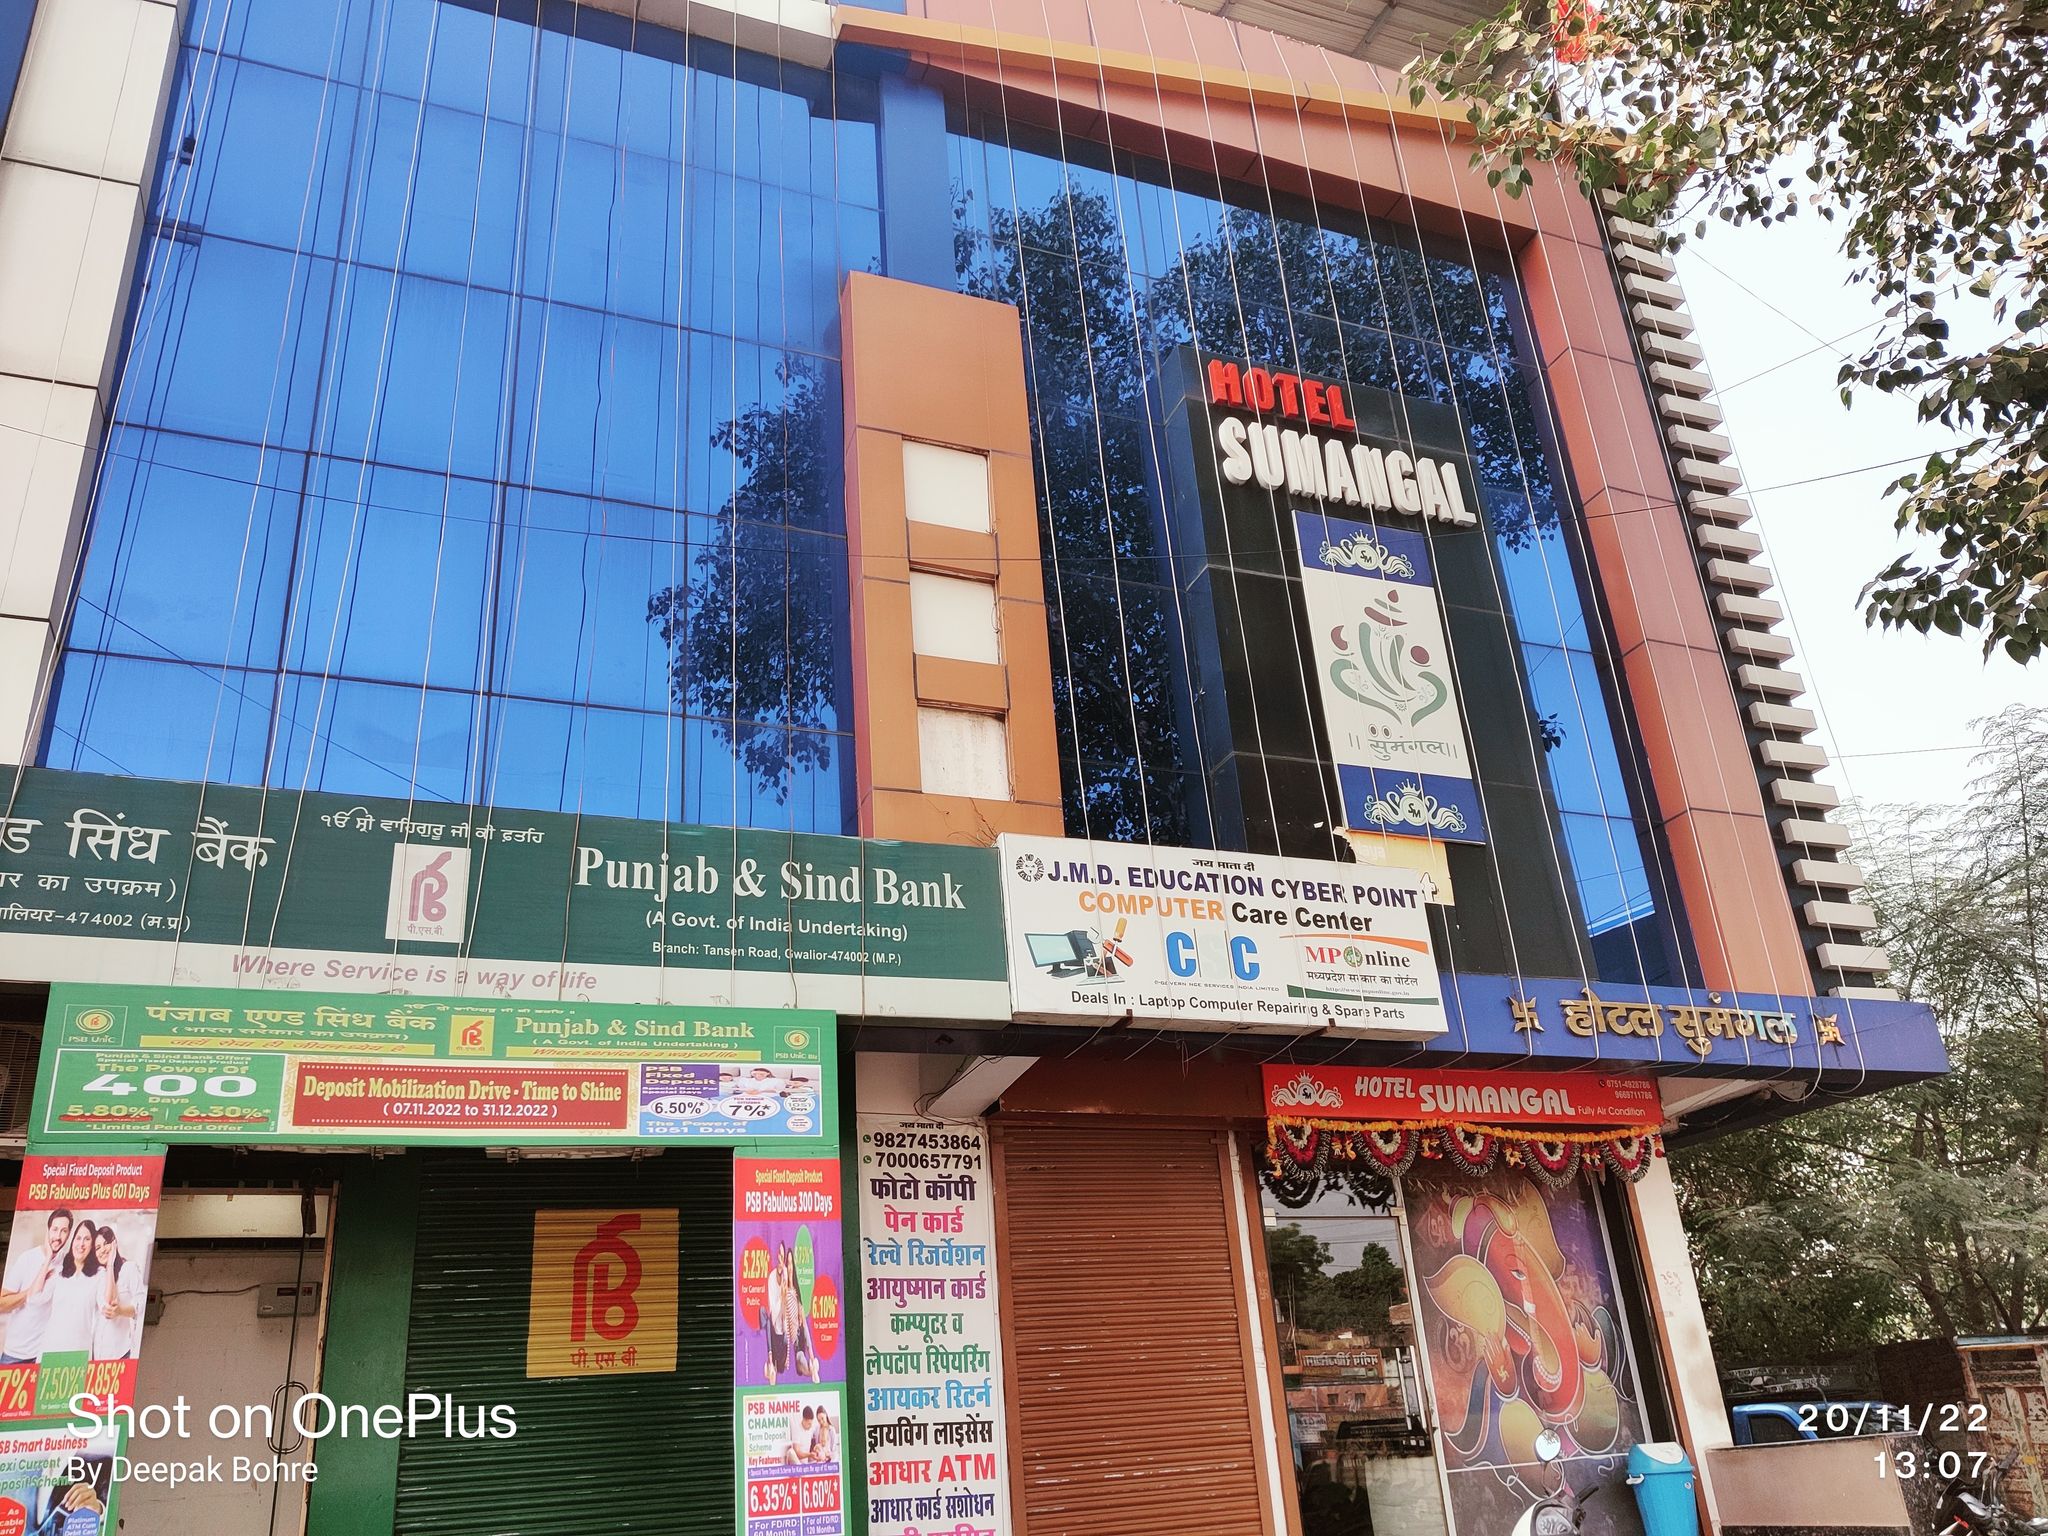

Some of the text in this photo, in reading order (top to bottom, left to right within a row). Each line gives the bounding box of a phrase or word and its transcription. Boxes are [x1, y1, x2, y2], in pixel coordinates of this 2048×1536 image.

[1207, 359, 1355, 431] HOTEL
[1218, 417, 1477, 526] SUMANGAL
[64, 808, 277, 871] सिंध बैंक
[37, 874, 70, 892] का
[574, 846, 966, 910] Punjab & Sind Bank
[1048, 861, 1120, 885] J.M.D.
[1128, 866, 1264, 897] EDUCATION
[1271, 878, 1347, 903] CYBER
[1353, 886, 1417, 909] POINT
[645, 910, 908, 942] (A Govt. of India Undertaking)
[1079, 891, 1372, 932] COMPUTER Care Center
[653, 942, 901, 966] Branch: Tansen Road, Gwalior-474002 (M.P.)
[232, 954, 598, 990] Where Service is a way of life
[145, 1000, 437, 1030] पंजाब एण्ड सिंध बैंक
[1071, 991, 1405, 1019] Deals In Laptop Computer Repairing & Spare Parts
[515, 1016, 754, 1038] Punjab & Sind Bank
[1559, 987, 1798, 1056] होटल सुमंगल
[96, 1064, 249, 1074] The Power Of
[82, 1074, 257, 1097] 400
[148, 1096, 190, 1104] Days
[303, 1075, 622, 1101] Deposit Mobilization Drive Time to Shine
[1355, 1076, 1576, 1116] HOTEL SUMANGAL
[393, 1102, 548, 1116] 07.11.2022 to 31.12.2022
[873, 1132, 981, 1150] 9827453864
[43, 1163, 142, 1179] Special Fixed Deposit Product
[875, 1152, 982, 1170] 7000657791
[29, 1183, 150, 1202] PSB Fabulous Plus 601 Days
[870, 1172, 976, 1200] फोटो कॉपी
[745, 1190, 833, 1217] PSB Fabulous 300 Days
[884, 1204, 964, 1233] पेन कार्ड
[908, 1237, 986, 1266] रिजर्वेशन
[867, 1270, 986, 1308] आयुष्मान कार्ड
[890, 1313, 964, 1343] कम्प्यूटर व
[865, 1344, 990, 1375] लेपटॉप रिपेयरिंग
[748, 1400, 800, 1415] PSB NANHE
[867, 1378, 992, 1411] आयकर रिटर्न
[748, 1416, 788, 1430] CHAMAN
[867, 1413, 994, 1453] ड्रायविंग लाइसेंस
[13, 1434, 88, 1452] Smart Business
[19, 1457, 60, 1471] Current
[869, 1459, 932, 1485] आधार
[938, 1453, 996, 1482] ATM
[870, 1486, 995, 1523] आधार कार्ड संशोधन
